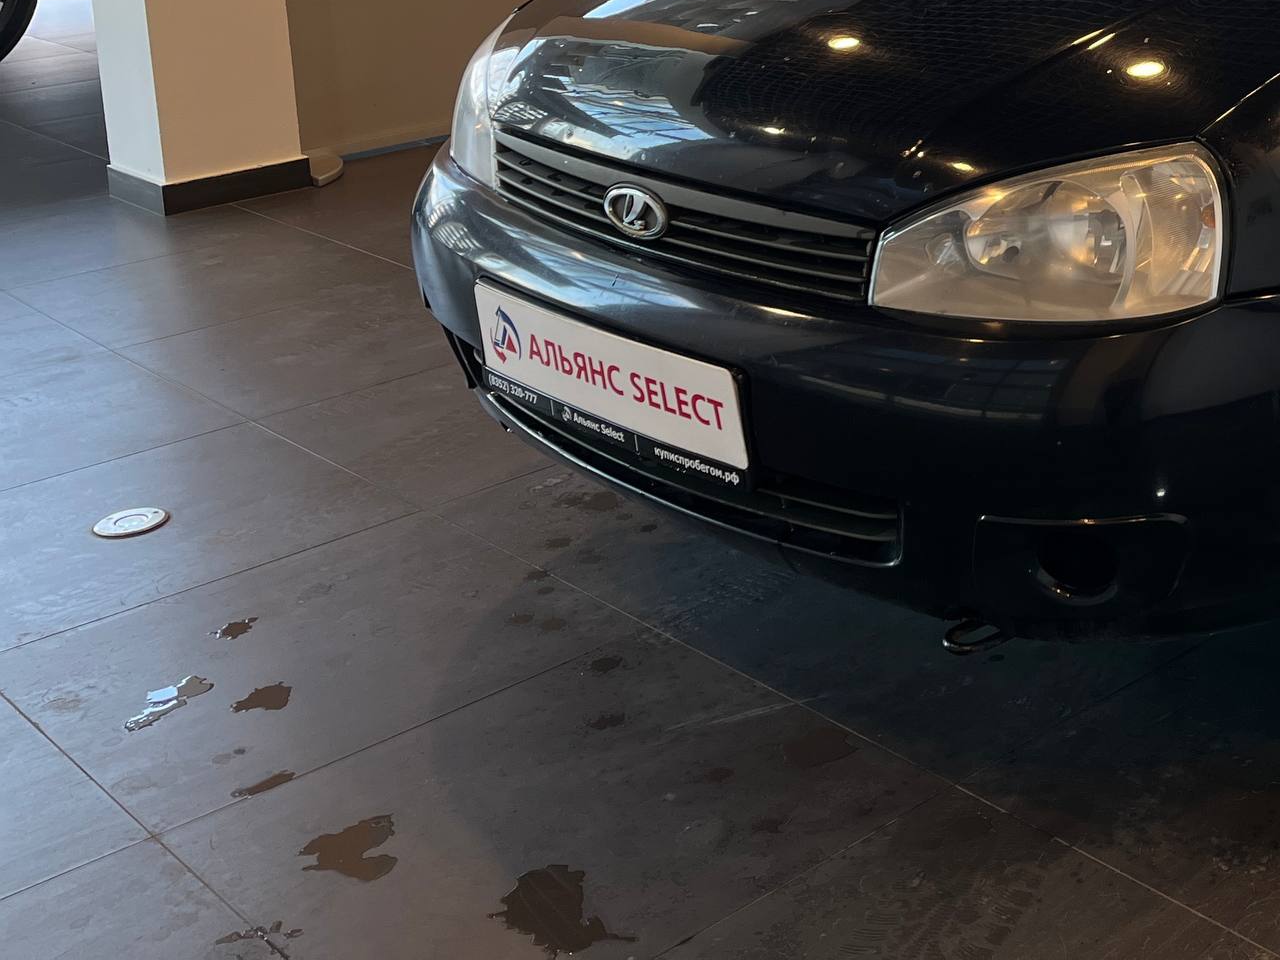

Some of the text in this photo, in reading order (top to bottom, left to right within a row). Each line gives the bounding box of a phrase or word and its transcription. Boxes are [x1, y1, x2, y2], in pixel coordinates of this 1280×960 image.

[510, 384, 538, 405] 320-777
[529, 334, 724, 431] АЛЬЯНС SELECT
[573, 412, 625, 443] Альянс Select
[653, 445, 741, 486] куписпробегом.рф
